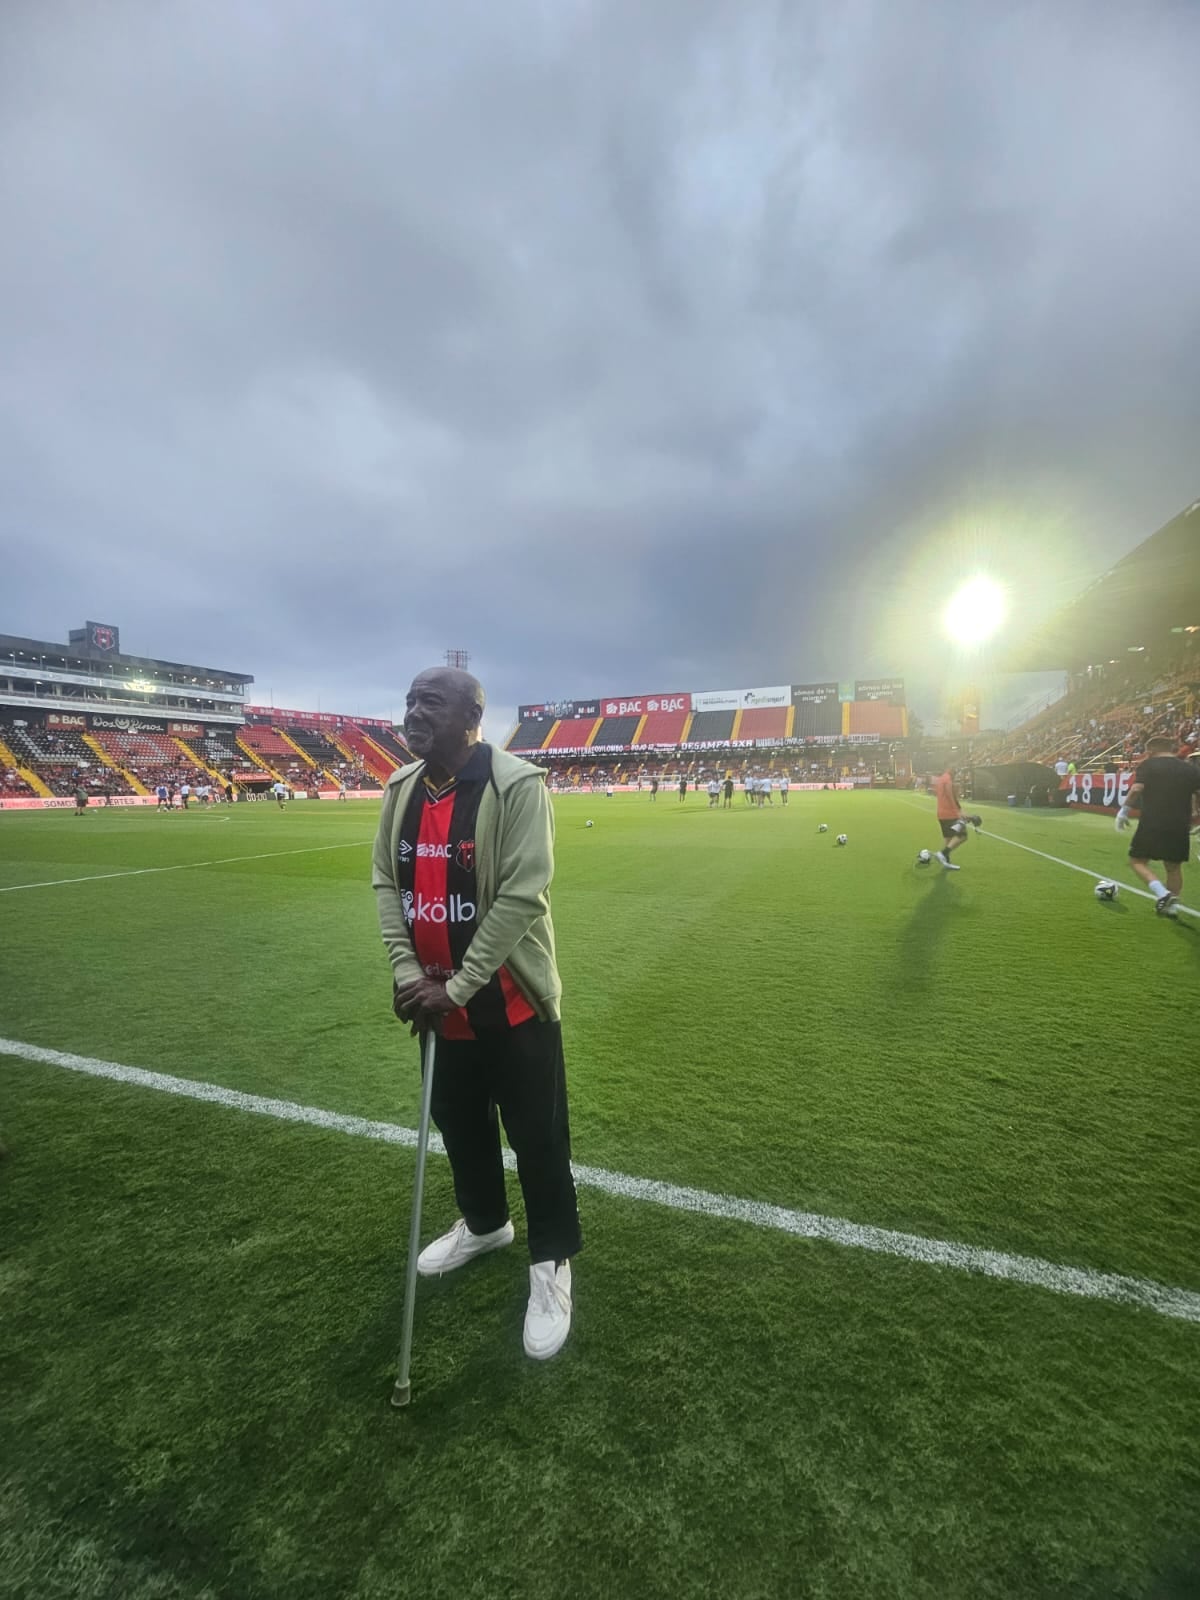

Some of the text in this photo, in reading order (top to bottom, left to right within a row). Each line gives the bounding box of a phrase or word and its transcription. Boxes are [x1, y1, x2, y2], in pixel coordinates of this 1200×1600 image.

[619, 700, 642, 713] BAC
[660, 698, 685, 711] BAC
[62, 715, 86, 725] BAC
[182, 723, 199, 733] BAC
[1066, 773, 1092, 804] 18
[428, 843, 452, 858] BAC
